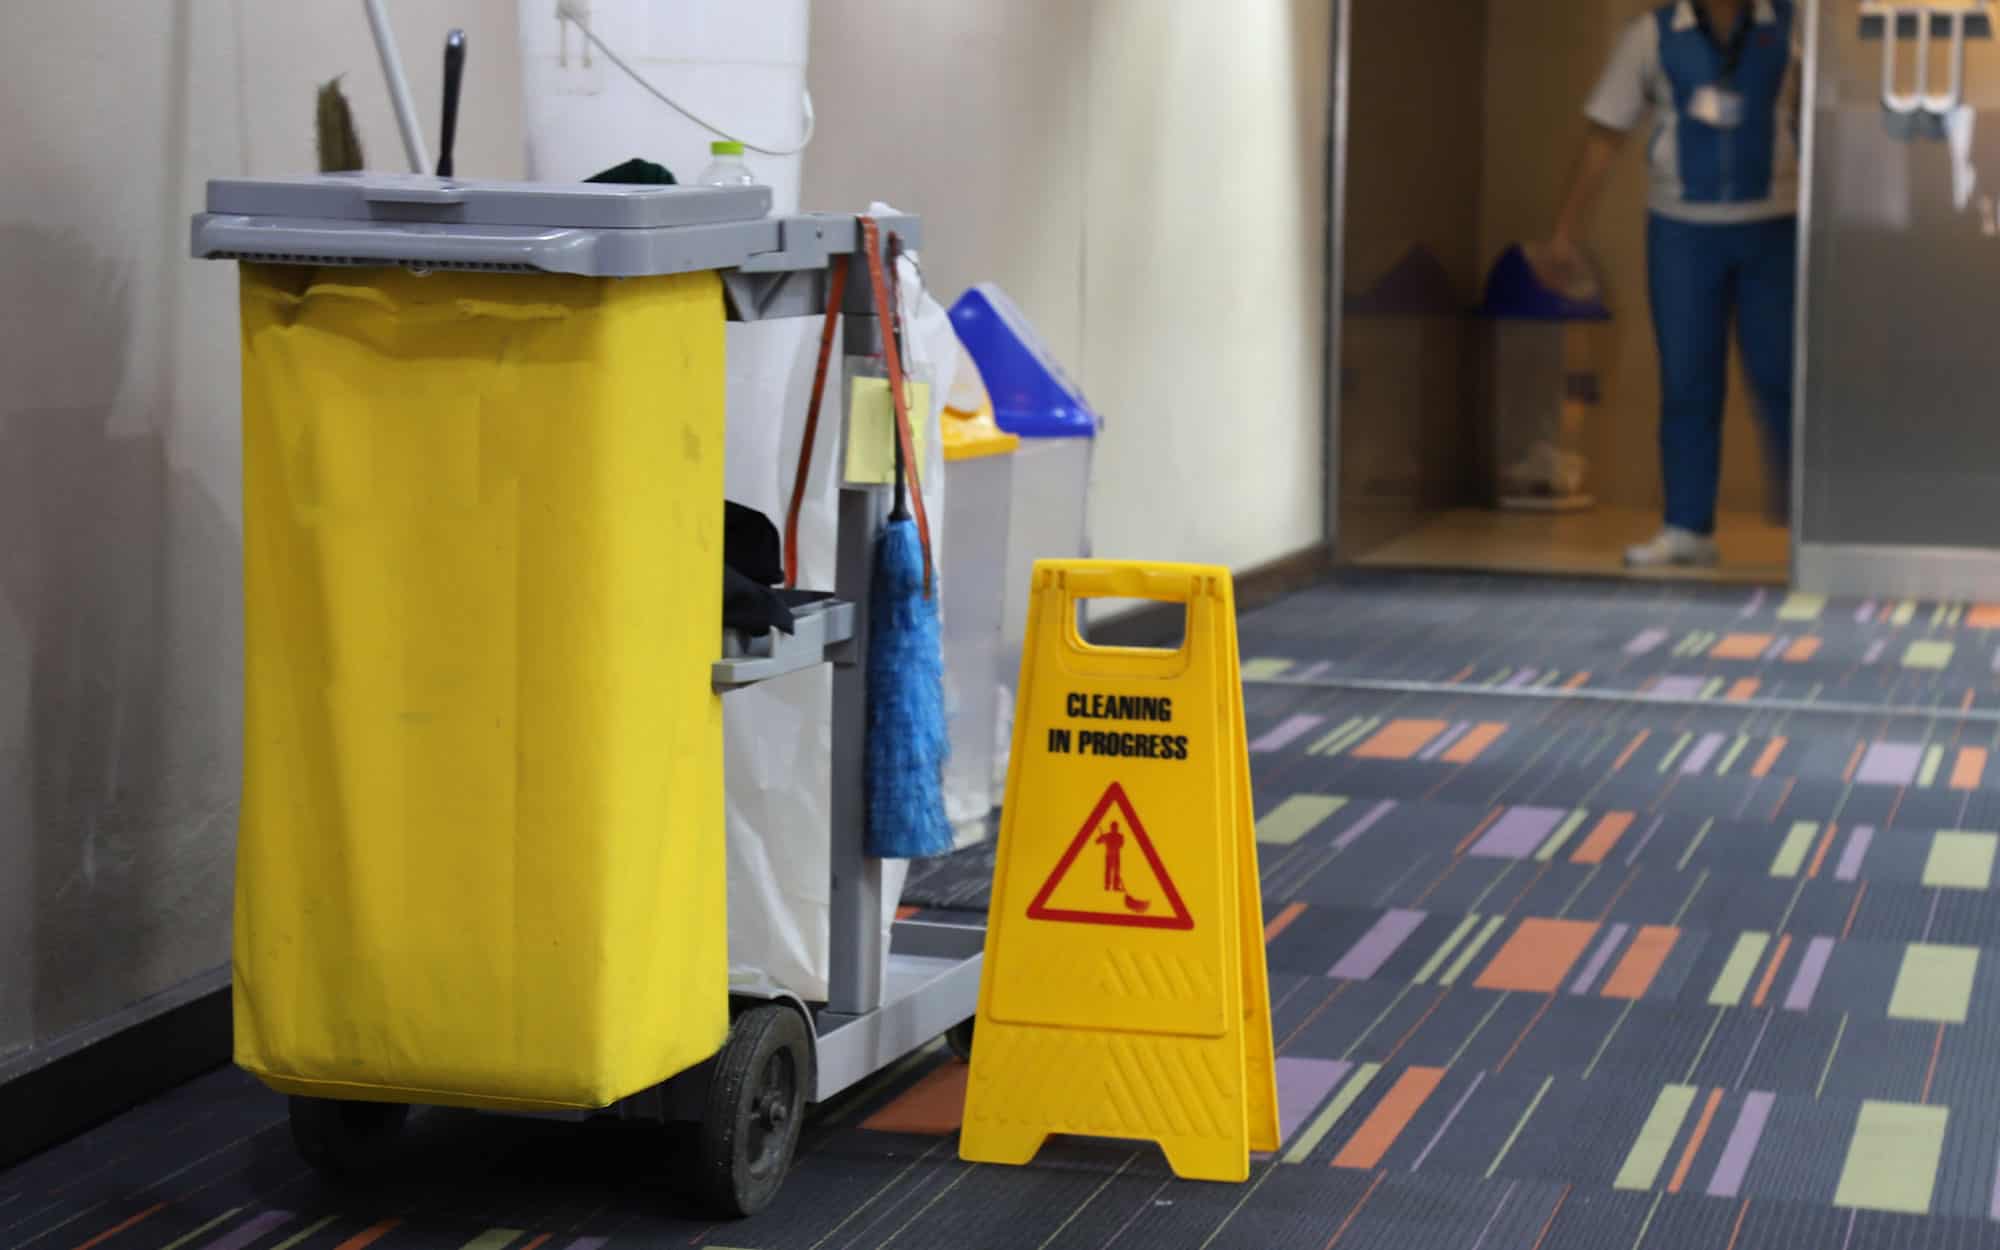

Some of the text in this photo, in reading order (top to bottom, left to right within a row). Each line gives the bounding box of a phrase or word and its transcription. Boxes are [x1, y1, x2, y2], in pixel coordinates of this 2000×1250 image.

[1067, 692, 1172, 722] CLEANING
[1048, 729, 1188, 760] IN PROGRESS
